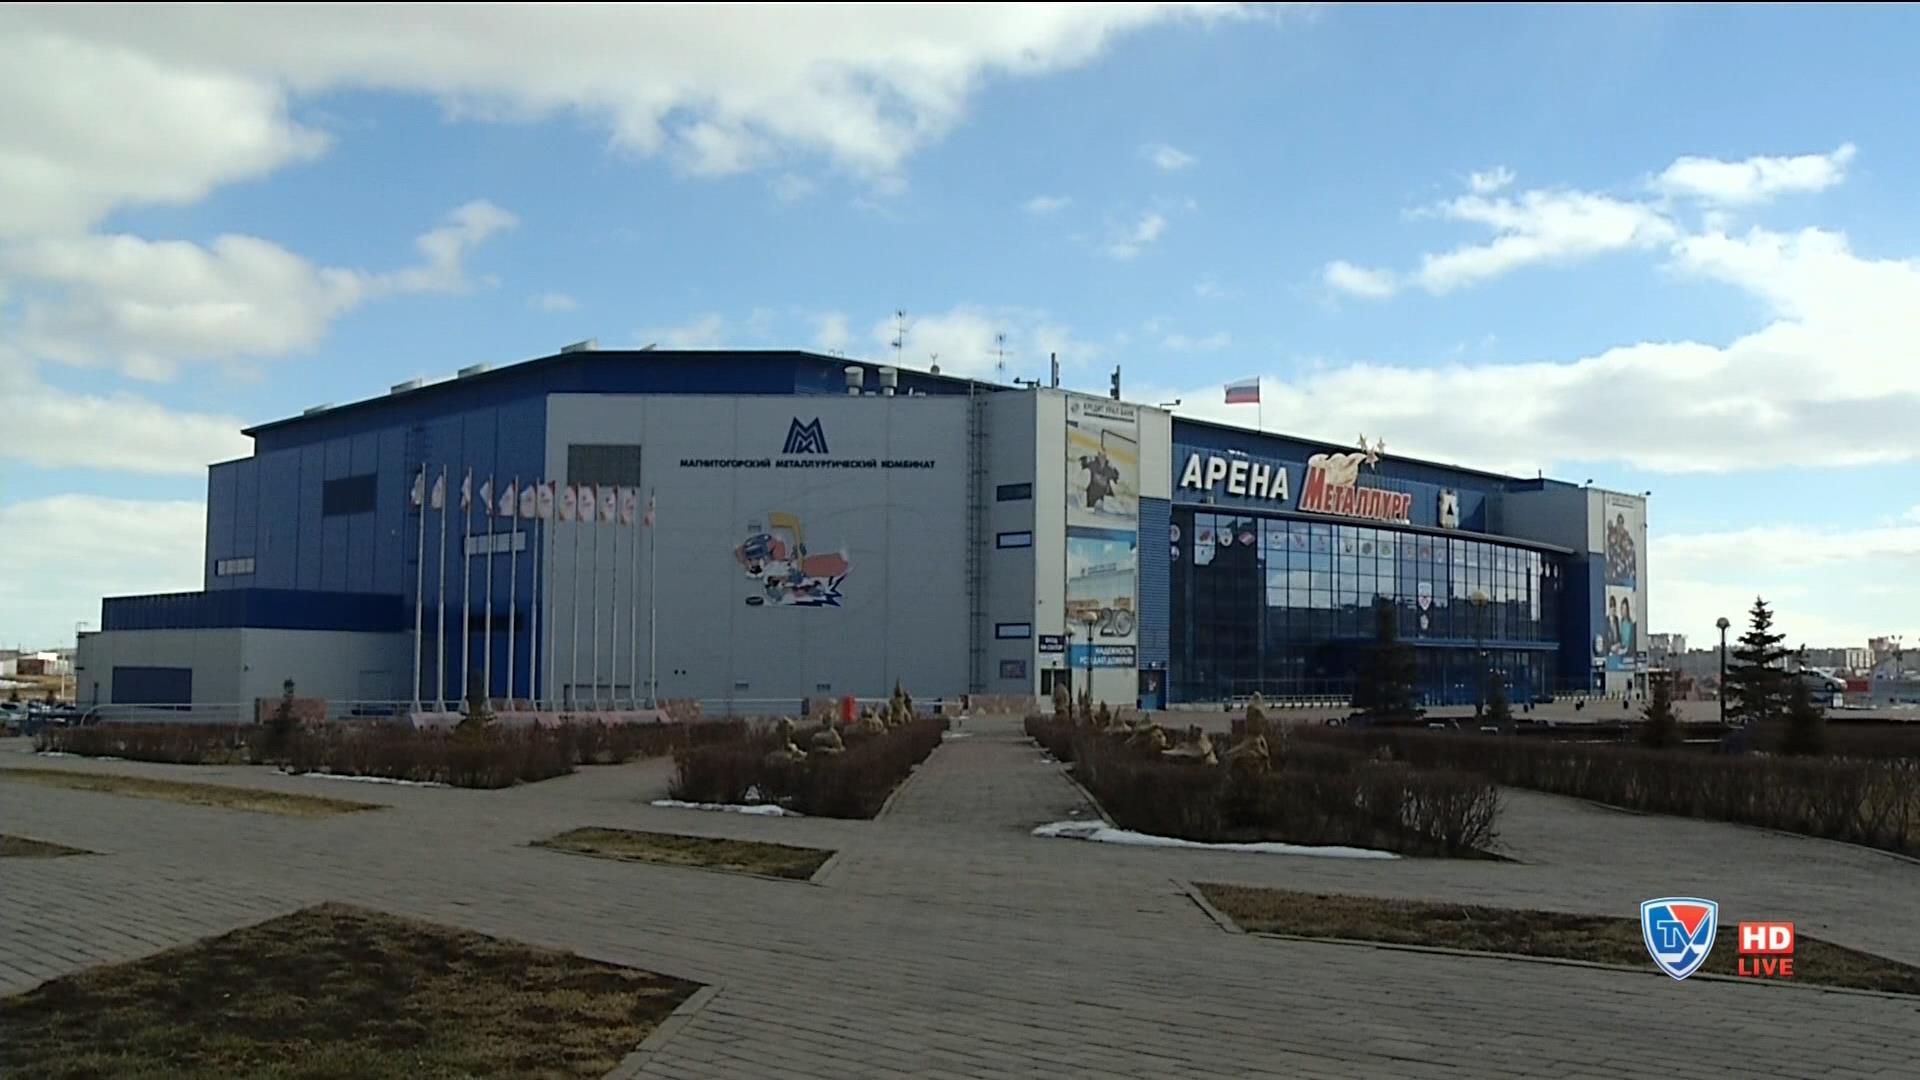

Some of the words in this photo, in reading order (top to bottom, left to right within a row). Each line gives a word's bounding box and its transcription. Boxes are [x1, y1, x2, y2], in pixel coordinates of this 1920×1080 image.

[680, 458, 771, 469] МАГНИТОГОРСКИЙ
[775, 458, 877, 469] МЕТАЛЛУРГИЧЕСКИЙ
[881, 459, 936, 469] КОМБИНАТ
[1180, 453, 1289, 500] АРЕНА
